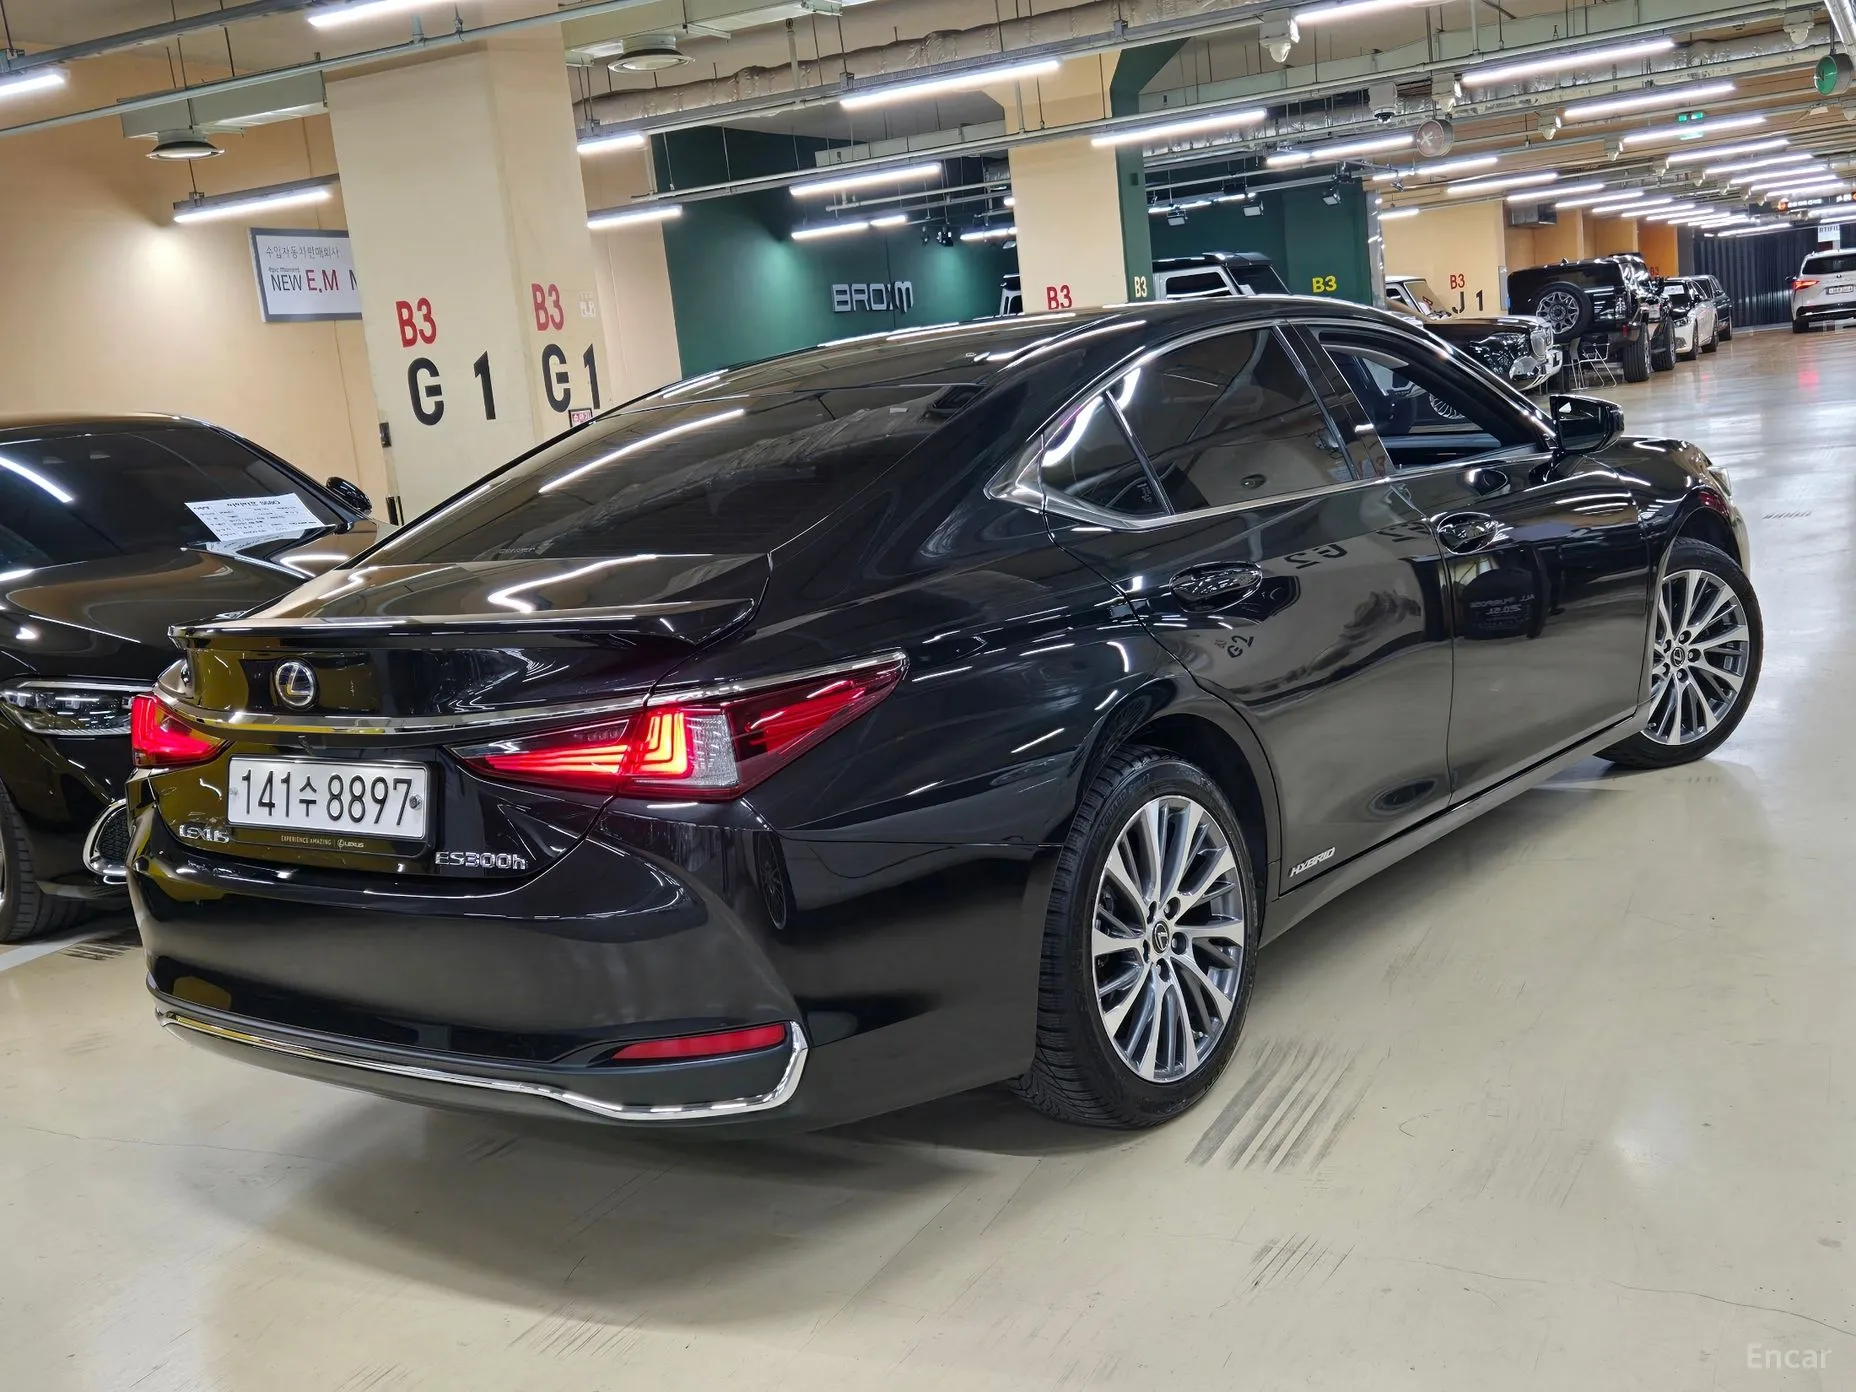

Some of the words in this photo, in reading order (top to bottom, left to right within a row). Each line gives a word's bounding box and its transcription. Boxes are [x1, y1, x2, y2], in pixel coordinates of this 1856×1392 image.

[270, 274, 302, 291] NEW
[1133, 275, 1148, 298] B3
[1312, 275, 1337, 293] B3
[1449, 273, 1466, 290] B3
[531, 283, 565, 332] B3
[1046, 284, 1073, 311] B3
[1451, 291, 1465, 314] J
[1475, 289, 1484, 312] 1
[395, 297, 437, 348] B3
[407, 357, 445, 426] G
[473, 350, 497, 421] 1
[242, 769, 412, 826] 141수8897
[281, 835, 309, 844] EXPERIENCE
[310, 838, 332, 846] AMAZING
[435, 851, 526, 870] ES300h
[1289, 846, 1336, 878] HYBRID
